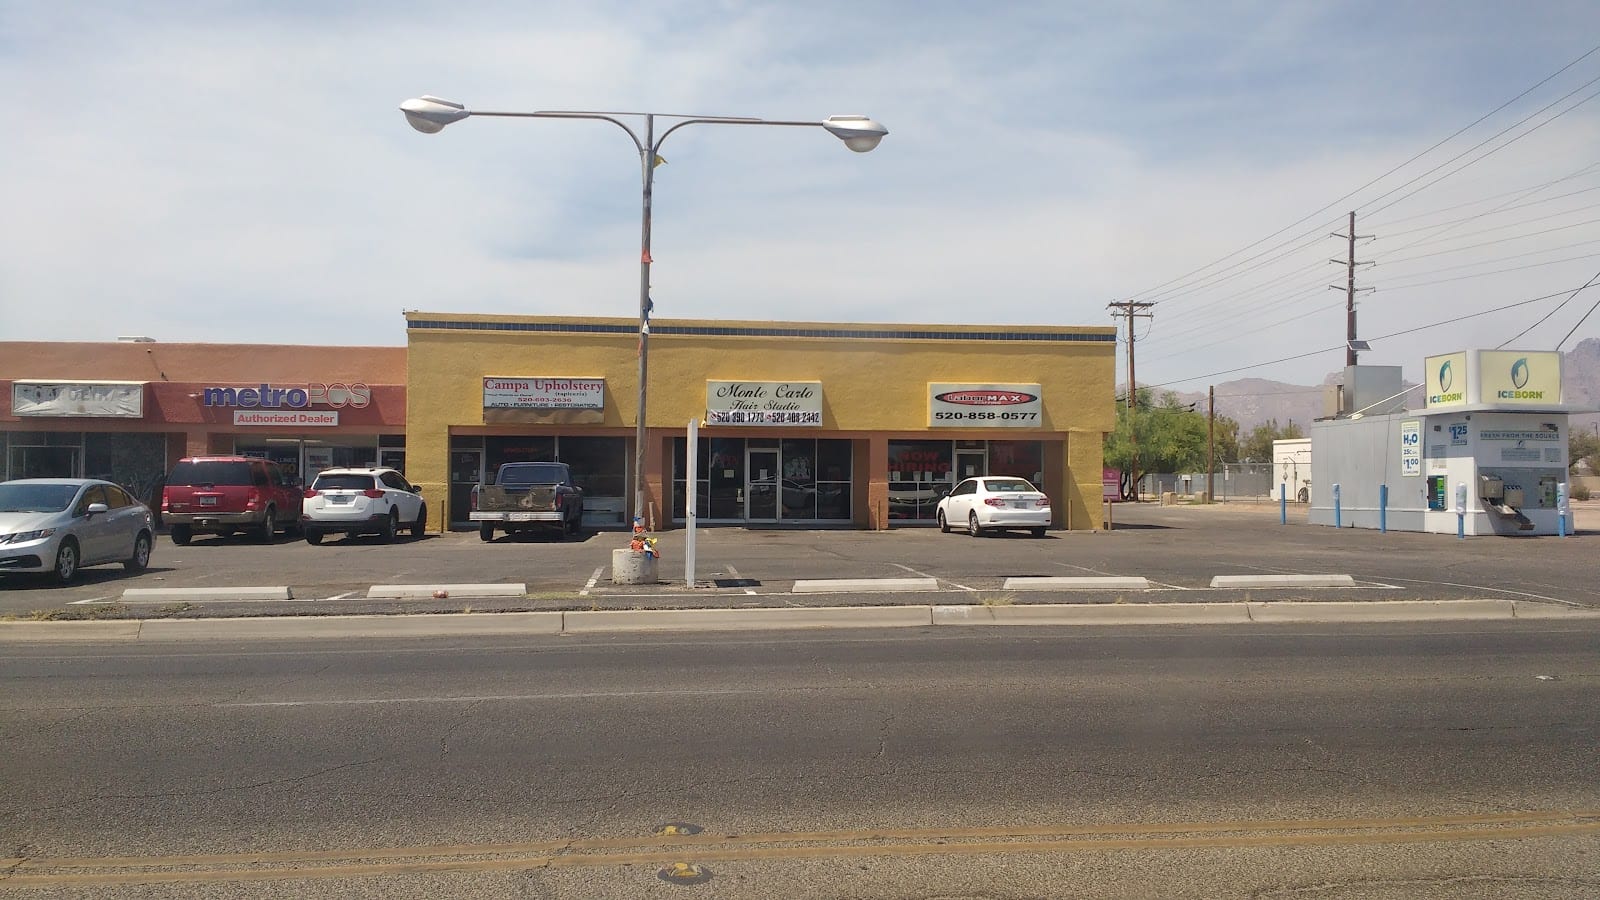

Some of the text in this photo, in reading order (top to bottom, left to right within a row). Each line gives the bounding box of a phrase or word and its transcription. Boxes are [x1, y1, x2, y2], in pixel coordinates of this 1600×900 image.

[484, 379, 603, 393] Campa Upholstery
[716, 384, 814, 398] Monte Carlo
[1430, 392, 1462, 404] ICEBORN
[1498, 390, 1543, 399] ICEBORN
[729, 400, 801, 411] Hair Studio
[237, 414, 335, 424] Authorized Dealer
[772, 412, 785, 423] 520
[935, 412, 1038, 420] 520-858-0577
